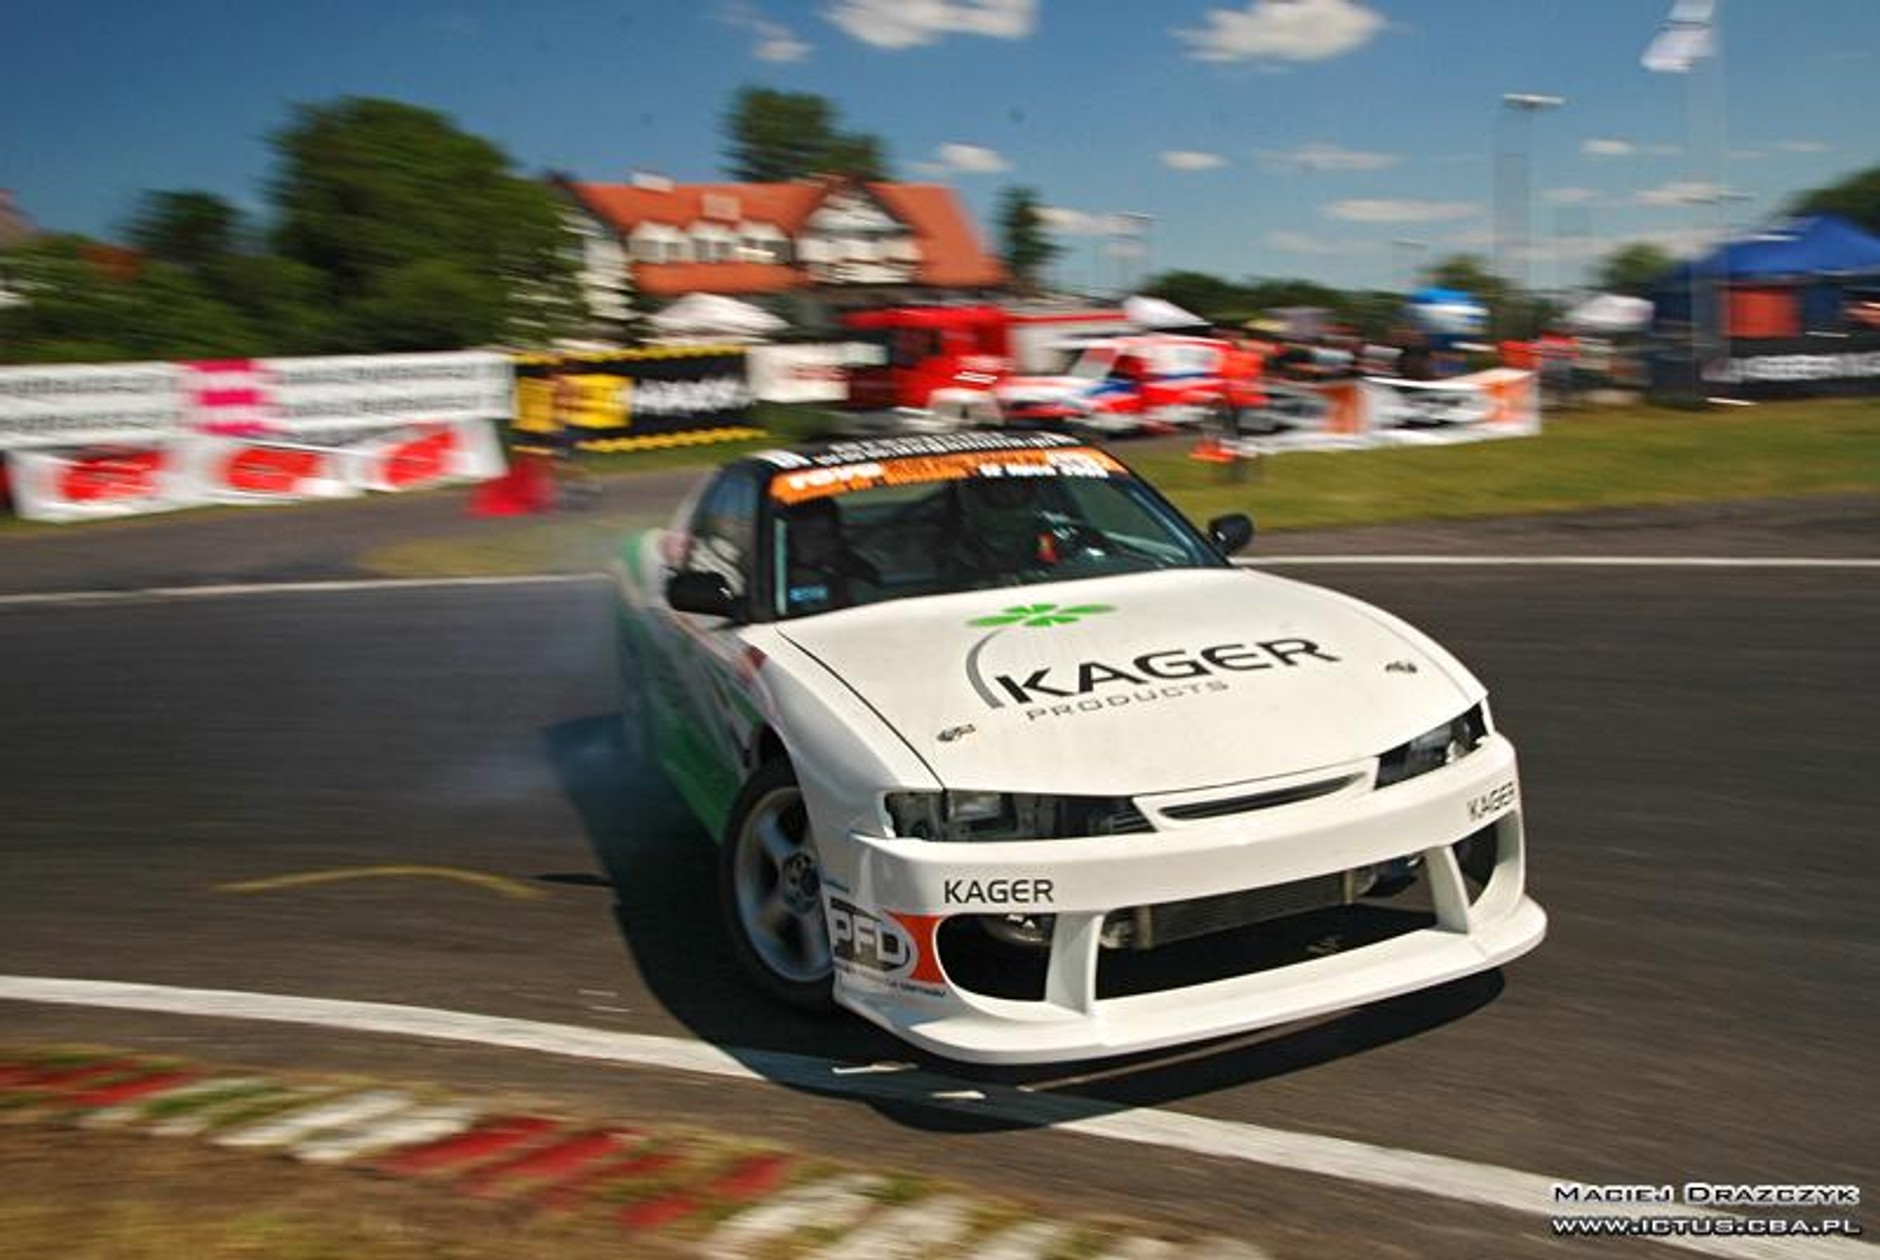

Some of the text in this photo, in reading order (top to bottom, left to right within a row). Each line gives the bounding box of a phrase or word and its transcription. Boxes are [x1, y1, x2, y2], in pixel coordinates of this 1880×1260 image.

[995, 637, 1342, 704] KAGER
[1025, 680, 1230, 721] PRODUCTS
[943, 878, 1055, 904] KAGER
[829, 905, 908, 966] PFD
